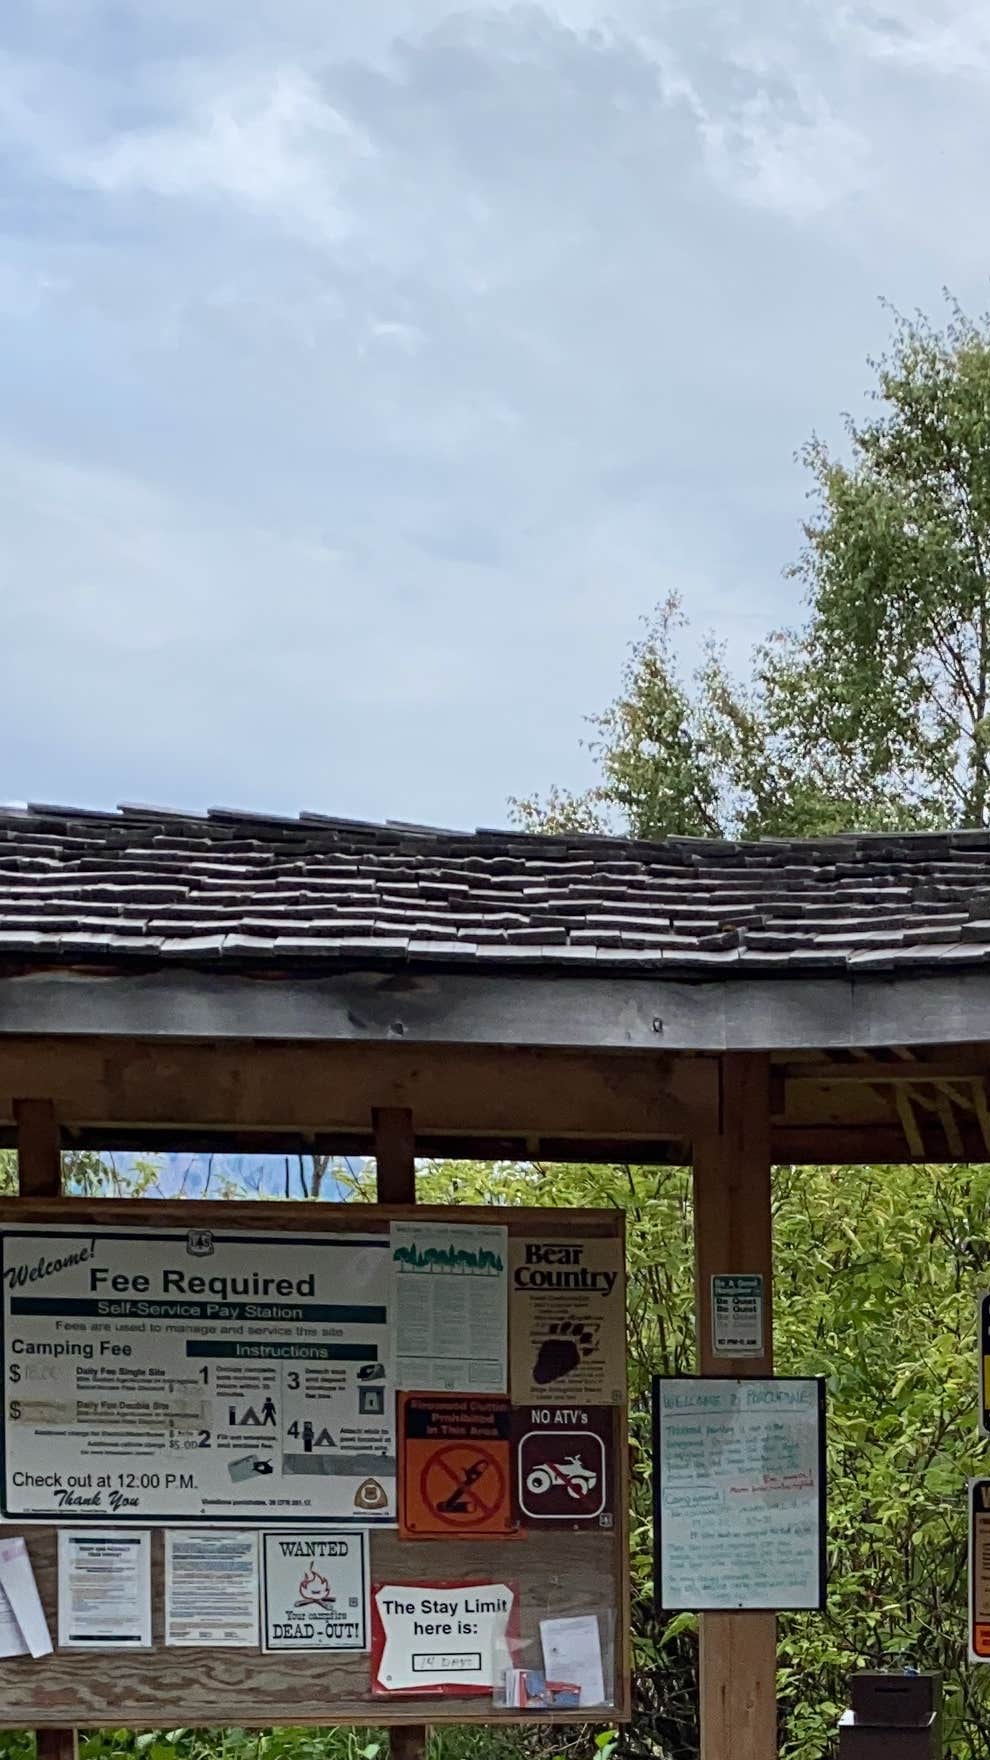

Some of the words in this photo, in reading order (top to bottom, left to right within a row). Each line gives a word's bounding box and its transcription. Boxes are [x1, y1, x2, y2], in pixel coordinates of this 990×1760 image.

[3, 1237, 96, 1288] Welcome!
[525, 1244, 583, 1264] Bear
[90, 1268, 150, 1293] Fee
[163, 1270, 316, 1301] Required
[514, 1266, 619, 1296] Country
[98, 1301, 200, 1316] Self-Service
[206, 1303, 240, 1318] Pay
[245, 1305, 304, 1320] Station
[56, 1320, 87, 1331] Fees
[91, 1322, 111, 1331] are
[116, 1321, 146, 1332] used
[150, 1322, 161, 1332] to
[166, 1325, 217, 1335] manage
[220, 1325, 244, 1335] and
[248, 1327, 293, 1337] service
[296, 1326, 318, 1337] this
[322, 1328, 344, 1338] site
[12, 1338, 94, 1358] Camping
[100, 1341, 132, 1356] Fee
[236, 1343, 329, 1358] Instructions
[9, 1364, 21, 1383] $
[199, 1366, 209, 1385] 1
[287, 1372, 300, 1390] 3
[9, 1401, 22, 1420] $
[531, 1409, 551, 1424] NO
[554, 1409, 588, 1424] ATV's
[198, 1430, 211, 1448] 2
[287, 1421, 300, 1440] 4
[12, 1472, 63, 1488] Check
[67, 1474, 93, 1488] out
[97, 1474, 112, 1488] at
[118, 1474, 161, 1489] 12:00
[165, 1475, 199, 1489] P.M.
[53, 1490, 102, 1507] Thank
[108, 1491, 141, 1511] You
[279, 1541, 349, 1558] WANTED
[383, 1600, 415, 1615] The
[421, 1599, 458, 1617] Stay
[464, 1598, 507, 1614] Limit
[414, 1621, 452, 1635] here
[458, 1620, 478, 1635] is:
